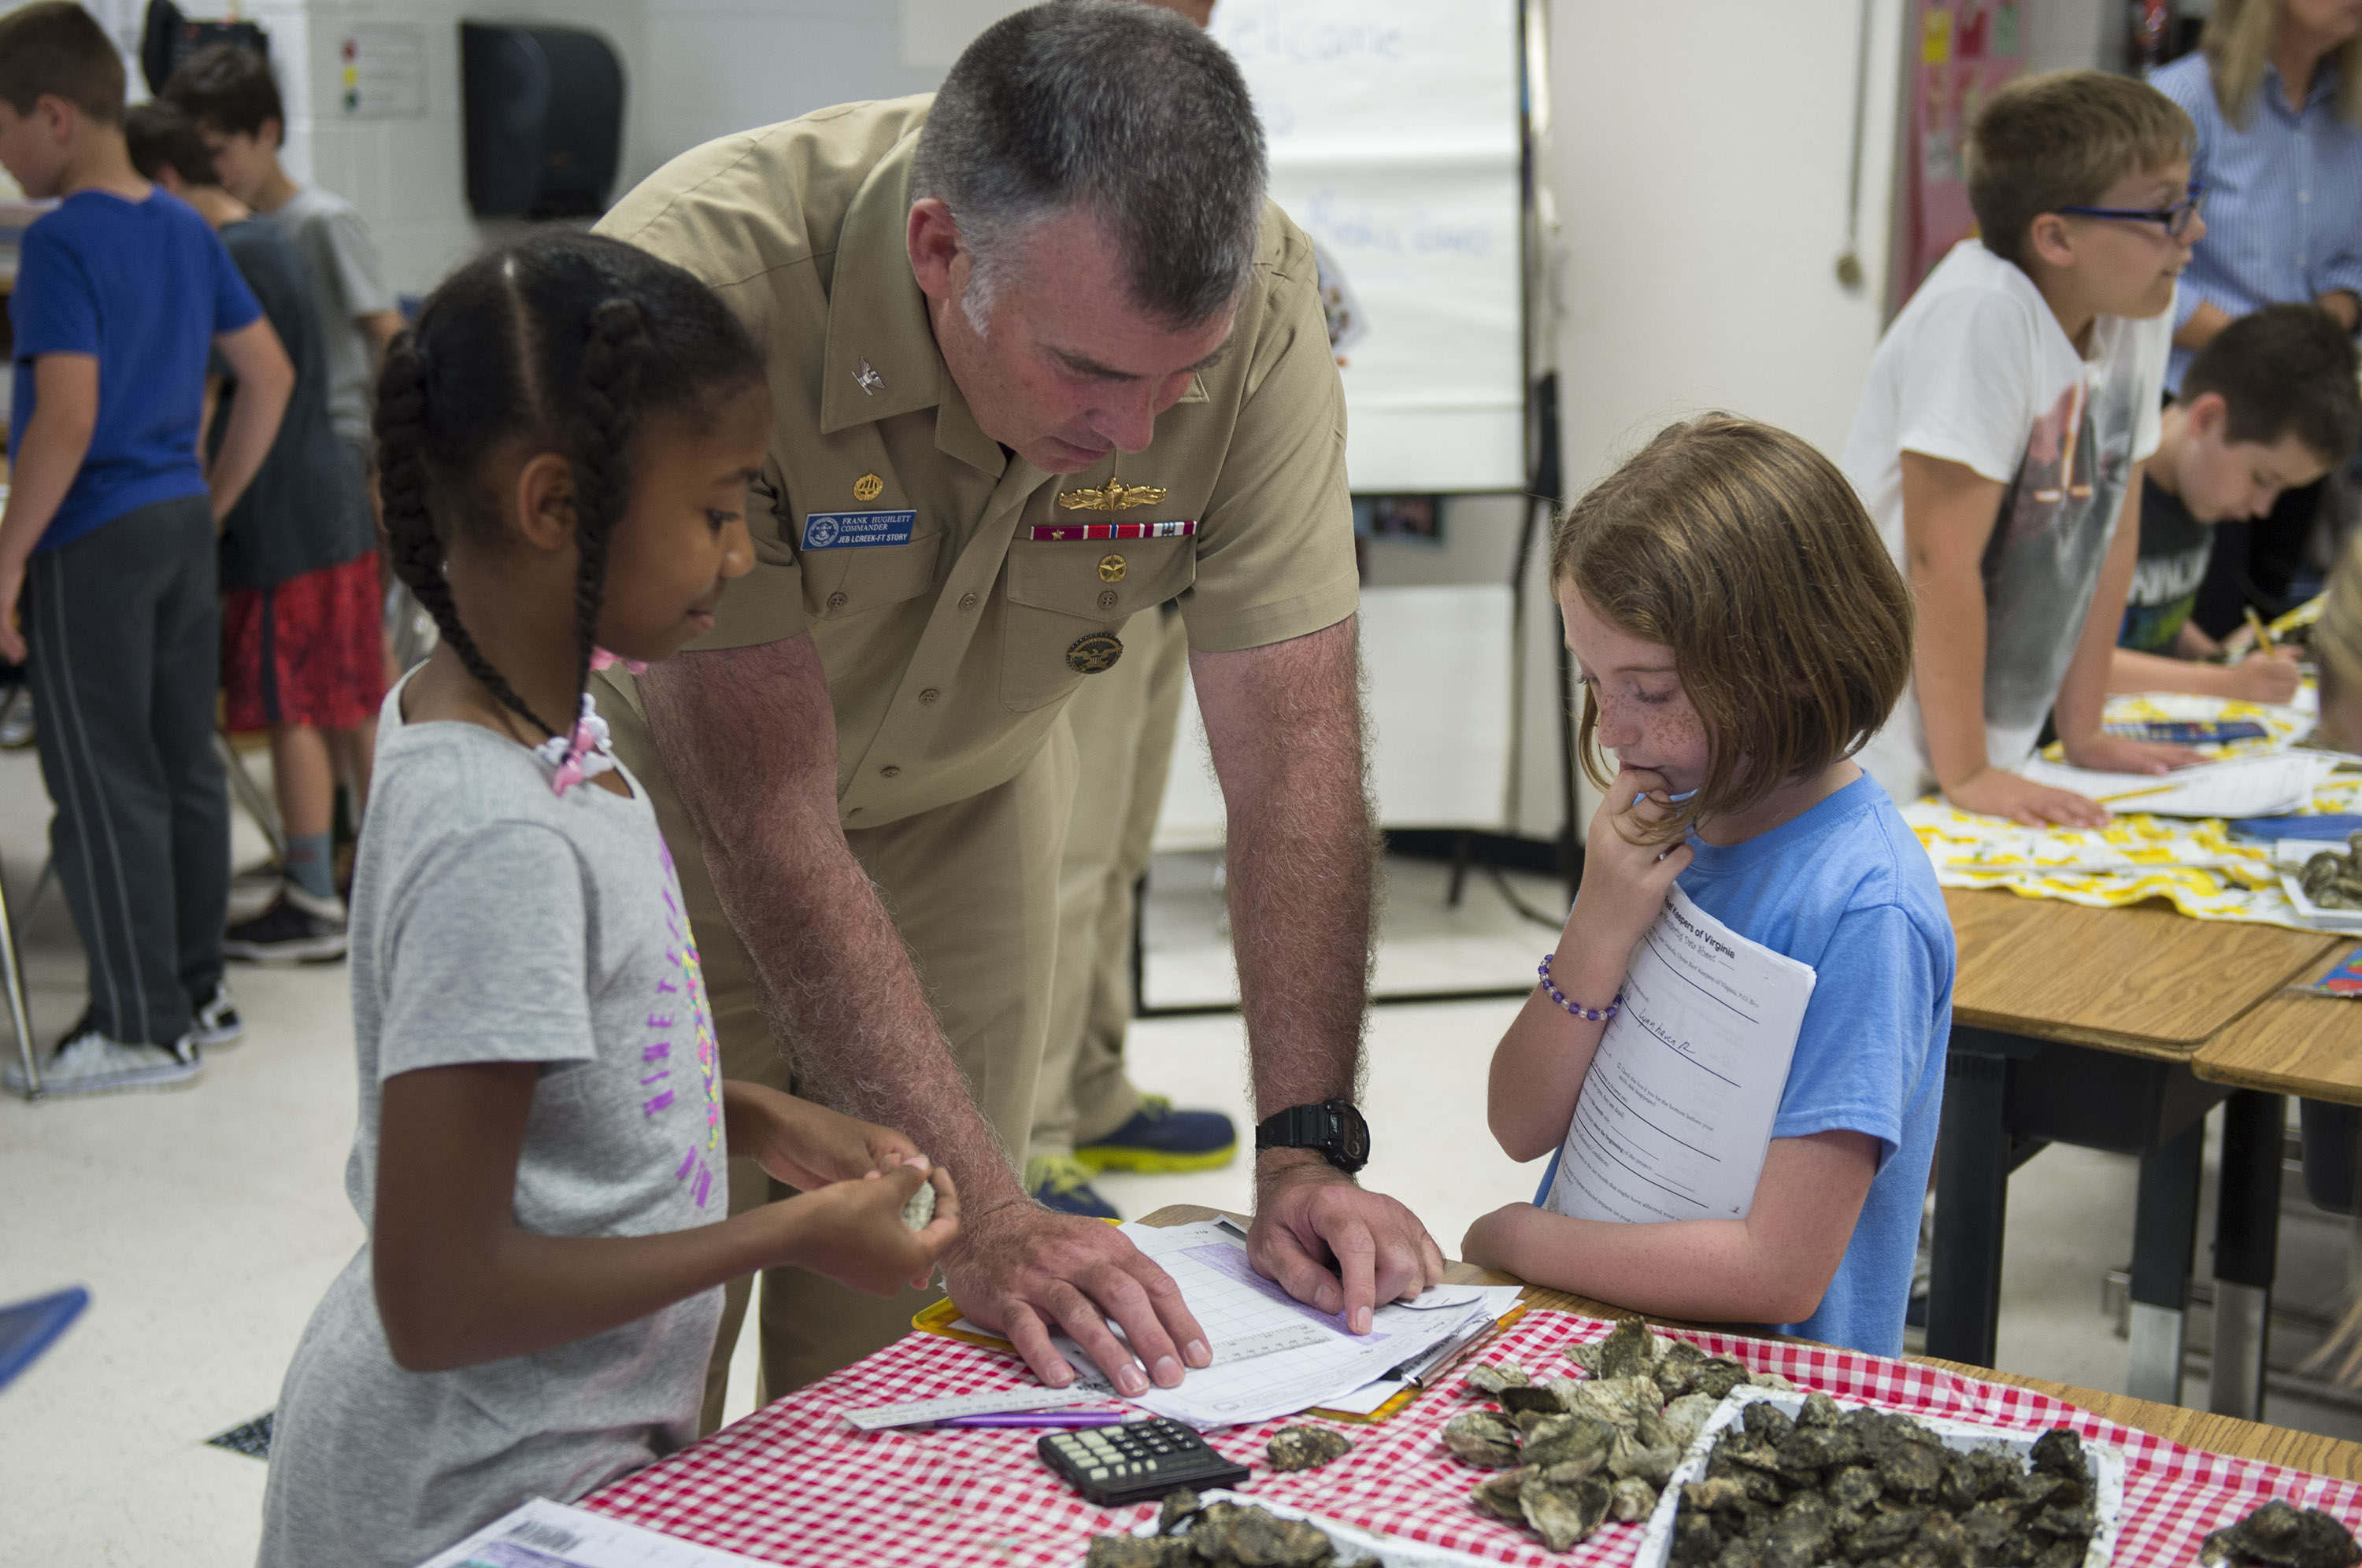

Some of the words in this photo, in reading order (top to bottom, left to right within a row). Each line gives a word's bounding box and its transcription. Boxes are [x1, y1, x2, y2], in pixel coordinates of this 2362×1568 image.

[840, 523, 888, 532] COMMANDER
[872, 515, 912, 523] HUGHLETT
[851, 534, 886, 543] LCREEK-FT
[886, 533, 908, 542] STORY
[1672, 906, 1695, 933] Keepers
[1694, 929, 1705, 939] of
[1705, 932, 1735, 960] Virginia
[1697, 945, 1716, 963] Sheet
[1686, 1113, 1702, 1126] before
[1702, 1122, 1715, 1132] your
[1605, 1133, 1624, 1154] beginning
[1630, 1196, 1642, 1206] have
[1663, 1210, 1676, 1221] your
